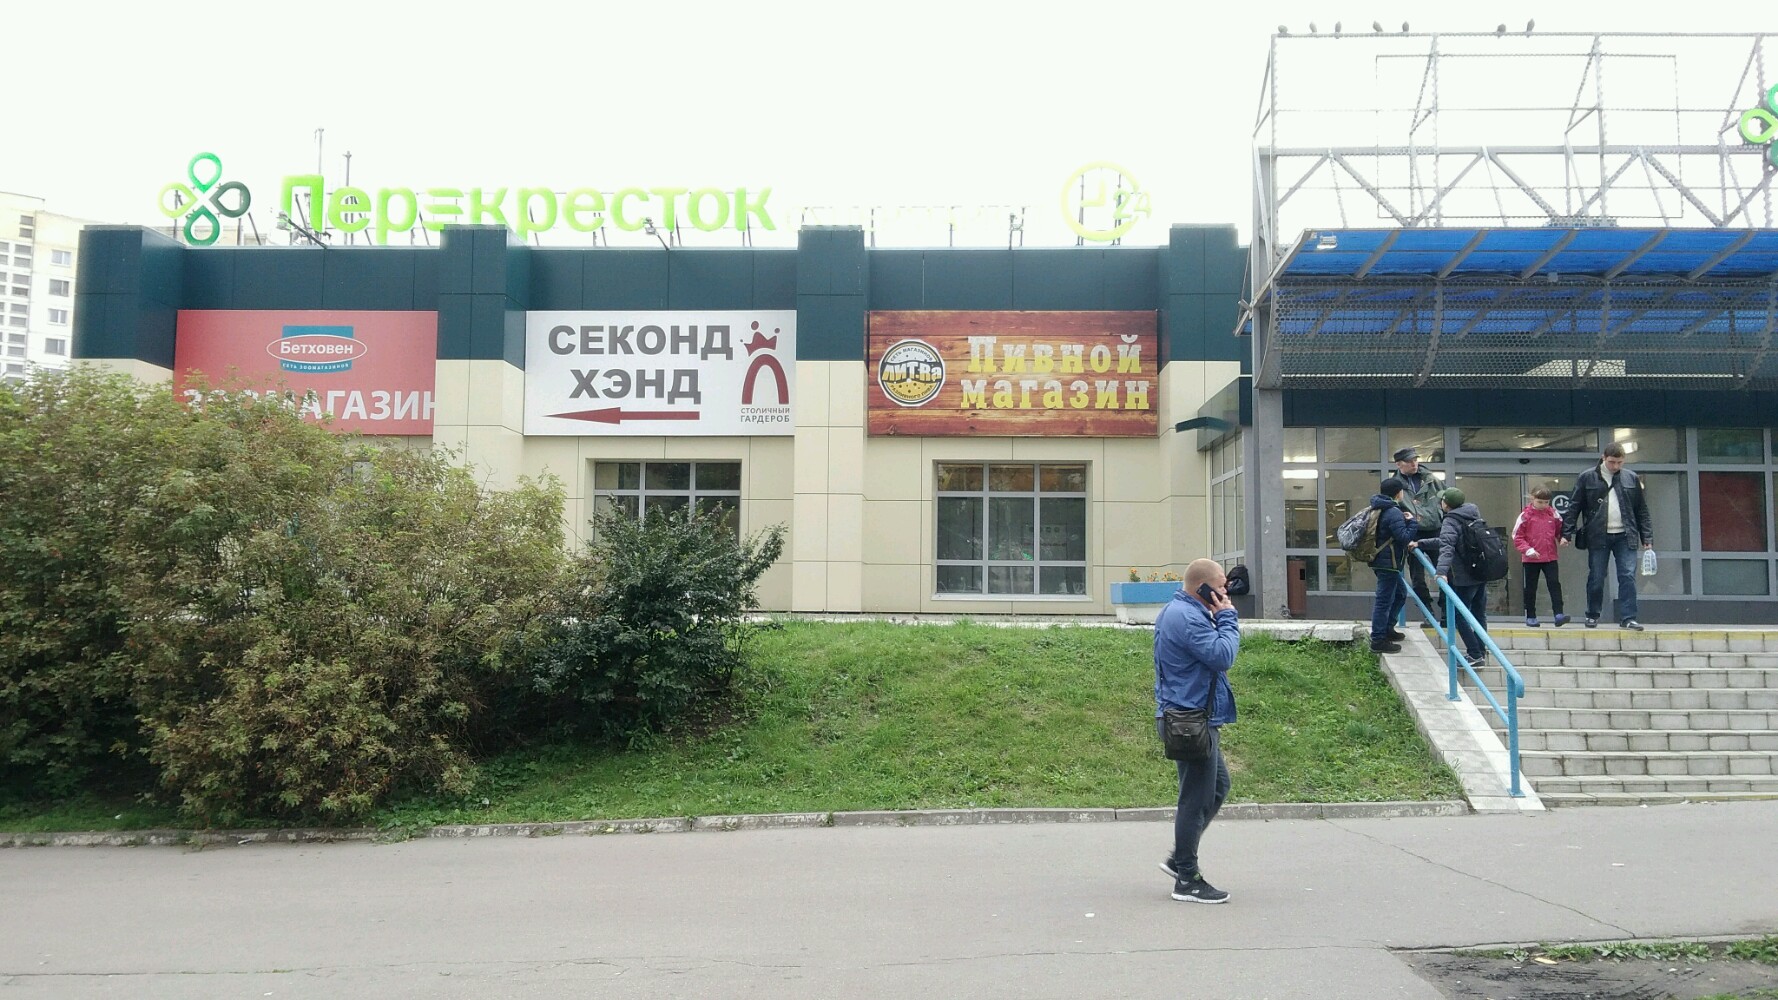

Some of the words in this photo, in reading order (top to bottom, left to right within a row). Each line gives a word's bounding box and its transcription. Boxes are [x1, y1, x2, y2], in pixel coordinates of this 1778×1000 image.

[280, 174, 776, 245] Перекресток
[281, 341, 353, 354] Бетховен
[548, 325, 733, 361] СЕКОНД
[891, 351, 902, 361] СЕТЬ
[902, 347, 933, 361] МАГАЗИНОВ
[967, 334, 1142, 374] Пивной
[568, 368, 701, 405] ХЭНД
[960, 379, 1150, 410] магазин
[740, 415, 790, 424] ГАРДЕРОБ
